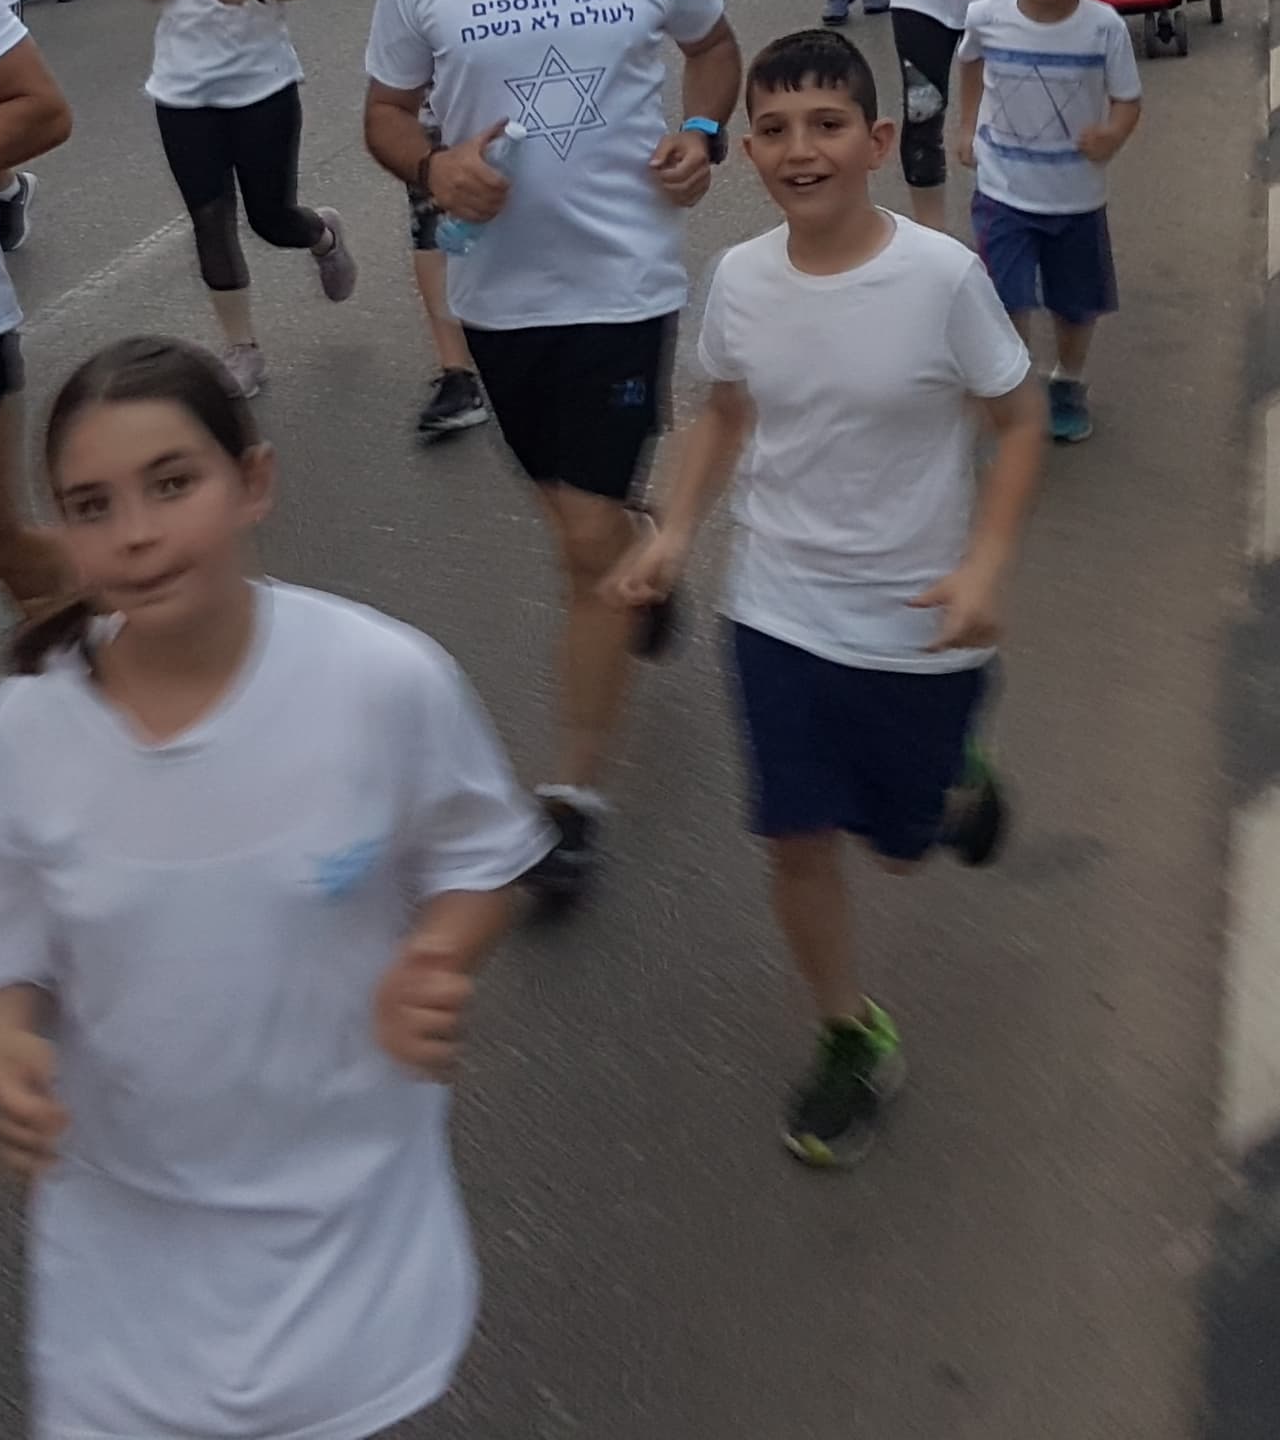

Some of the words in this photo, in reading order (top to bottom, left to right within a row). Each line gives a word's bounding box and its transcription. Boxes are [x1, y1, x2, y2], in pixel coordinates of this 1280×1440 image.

[531, 10, 560, 32] לא
[570, 1, 636, 27] לעולם
[460, 19, 522, 44] נשכח
